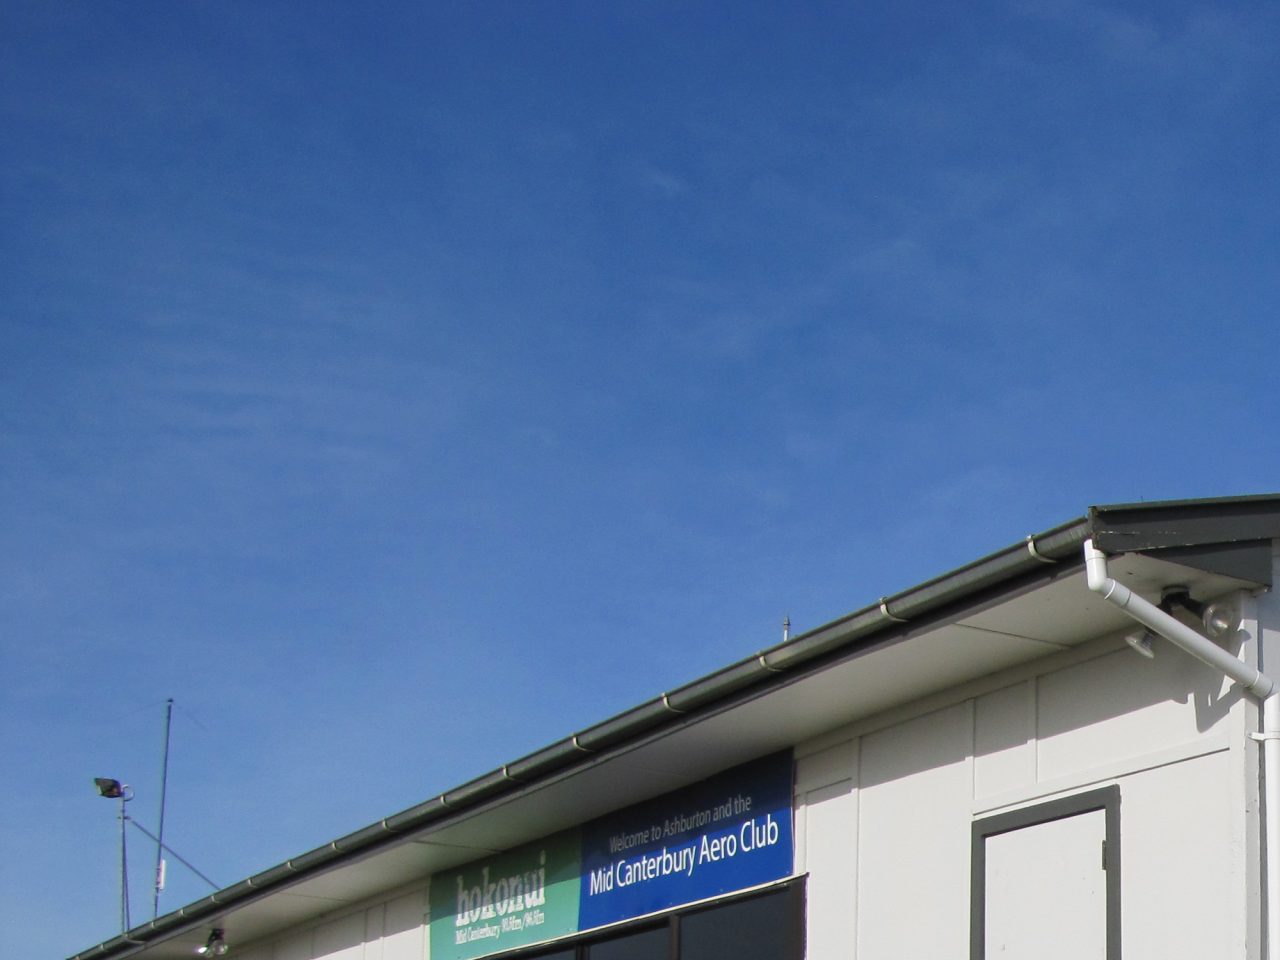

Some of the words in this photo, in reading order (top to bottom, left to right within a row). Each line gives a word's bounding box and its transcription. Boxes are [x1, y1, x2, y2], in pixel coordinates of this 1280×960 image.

[590, 863, 614, 896] Mid
[616, 845, 696, 887] Canterbury
[699, 834, 736, 865] Aero
[740, 814, 779, 851] Club
[609, 829, 650, 853] Welcome
[651, 825, 662, 841] to
[663, 808, 711, 837] Ashburton
[713, 797, 733, 821] and
[734, 793, 752, 815] the
[455, 850, 545, 927] hokonui
